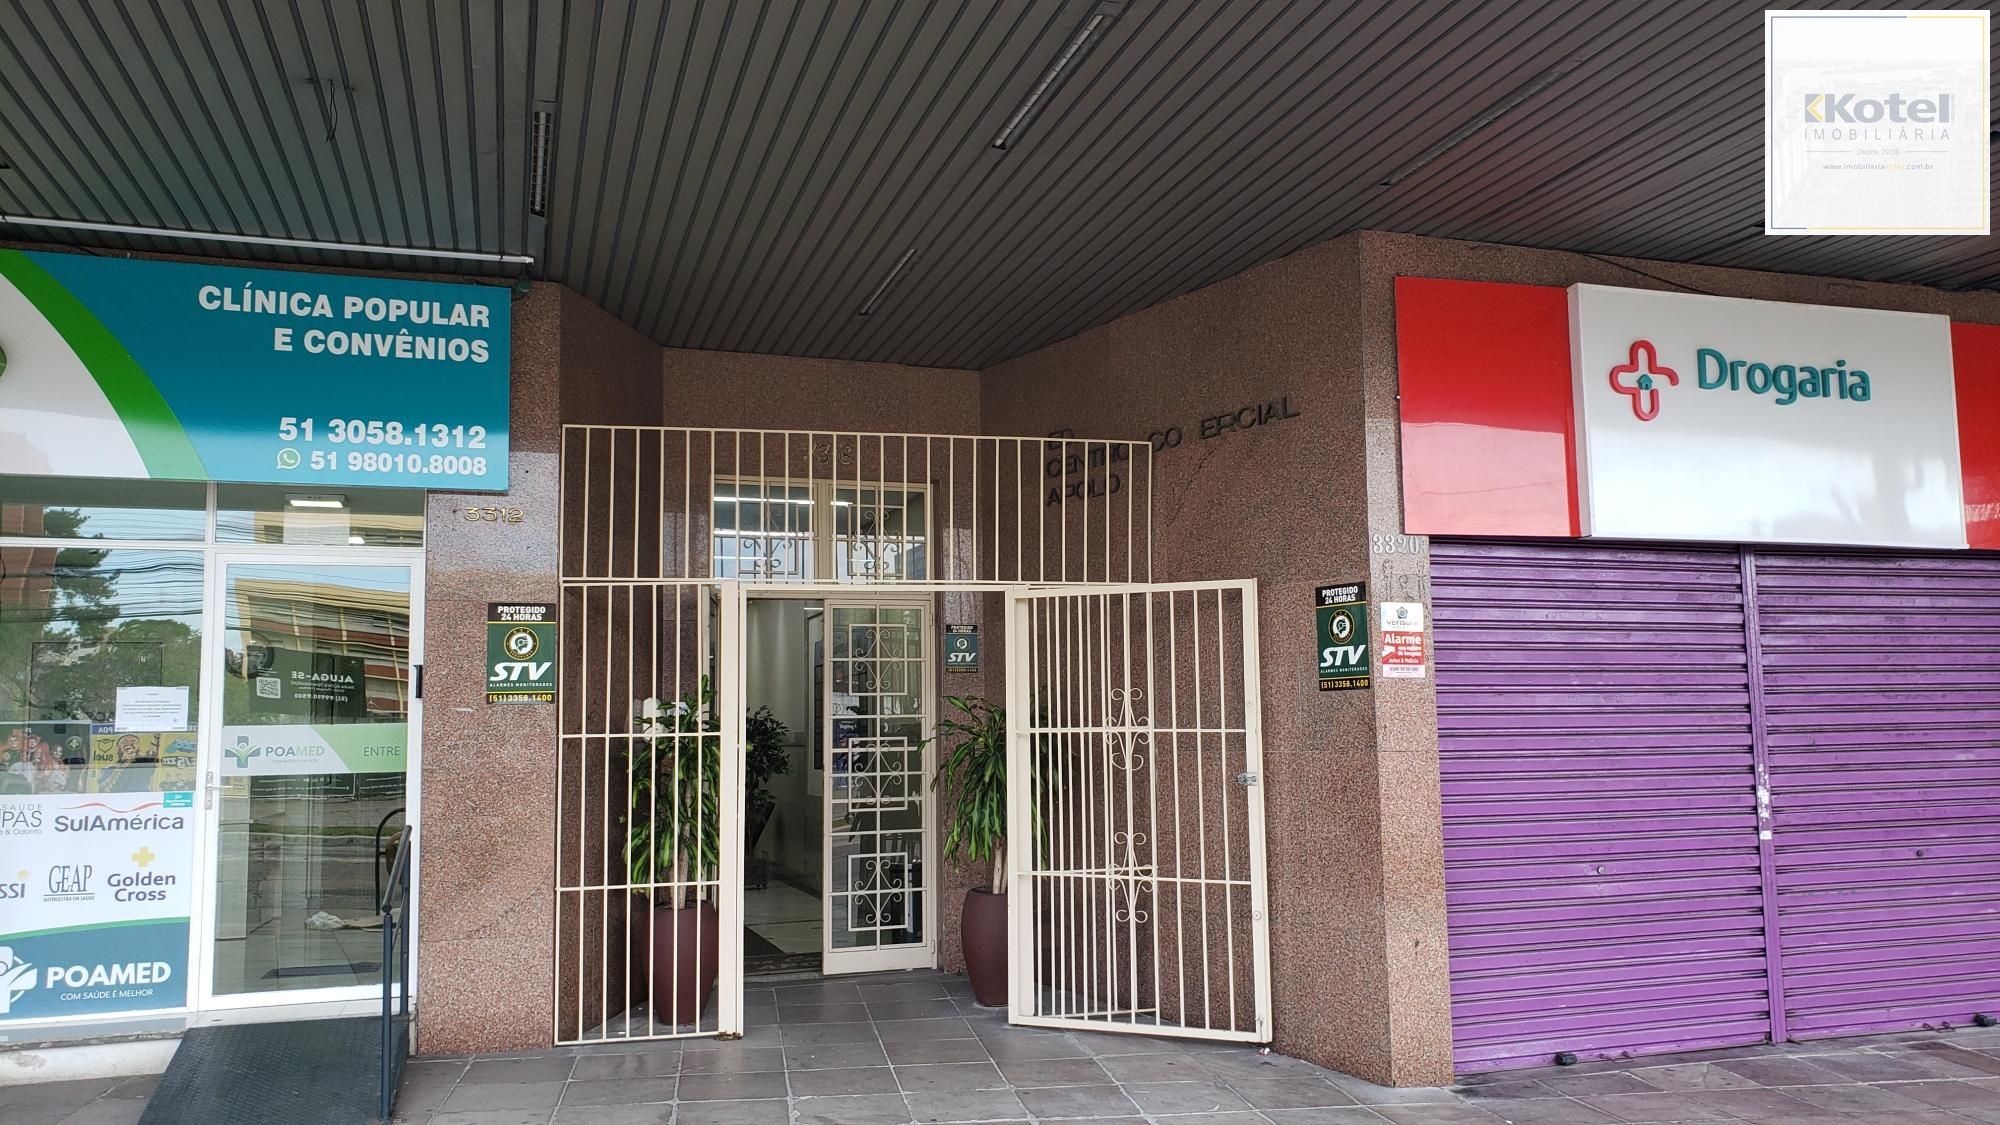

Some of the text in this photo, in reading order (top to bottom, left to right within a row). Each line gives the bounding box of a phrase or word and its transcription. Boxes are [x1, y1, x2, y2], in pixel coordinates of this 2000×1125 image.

[198, 281, 490, 328] CLÍNICA POPULAR
[274, 327, 489, 363] E CONVÊNIOS
[1696, 348, 1872, 405] Drogaria
[278, 416, 487, 449] 51 3058.1312
[310, 450, 487, 475] 51 98010.8008
[464, 507, 524, 523] 3312
[1372, 533, 1421, 555] 3320
[1322, 585, 1359, 597] PROTEGIDO
[1325, 594, 1356, 605] 24 HORAS
[497, 605, 546, 614] PROTEGIDO
[501, 613, 543, 621] 24 HORAS
[1384, 633, 1422, 645] Alarme
[947, 652, 977, 662] STV
[1320, 644, 1366, 668] STV
[489, 661, 553, 682] STV
[1321, 679, 1369, 689] (51)3358.1400
[489, 694, 553, 703] (51)3358.1400
[265, 746, 402, 758] POAMED ENTRE
[0, 810, 42, 828] PAS
[54, 813, 184, 833] SulAmérica
[48, 864, 93, 894] GEAP
[107, 872, 177, 888] Golden
[114, 889, 167, 903] Cross
[46, 961, 172, 989] POAMED
[60, 988, 154, 1001] COM SAÚDE É MELHOR
